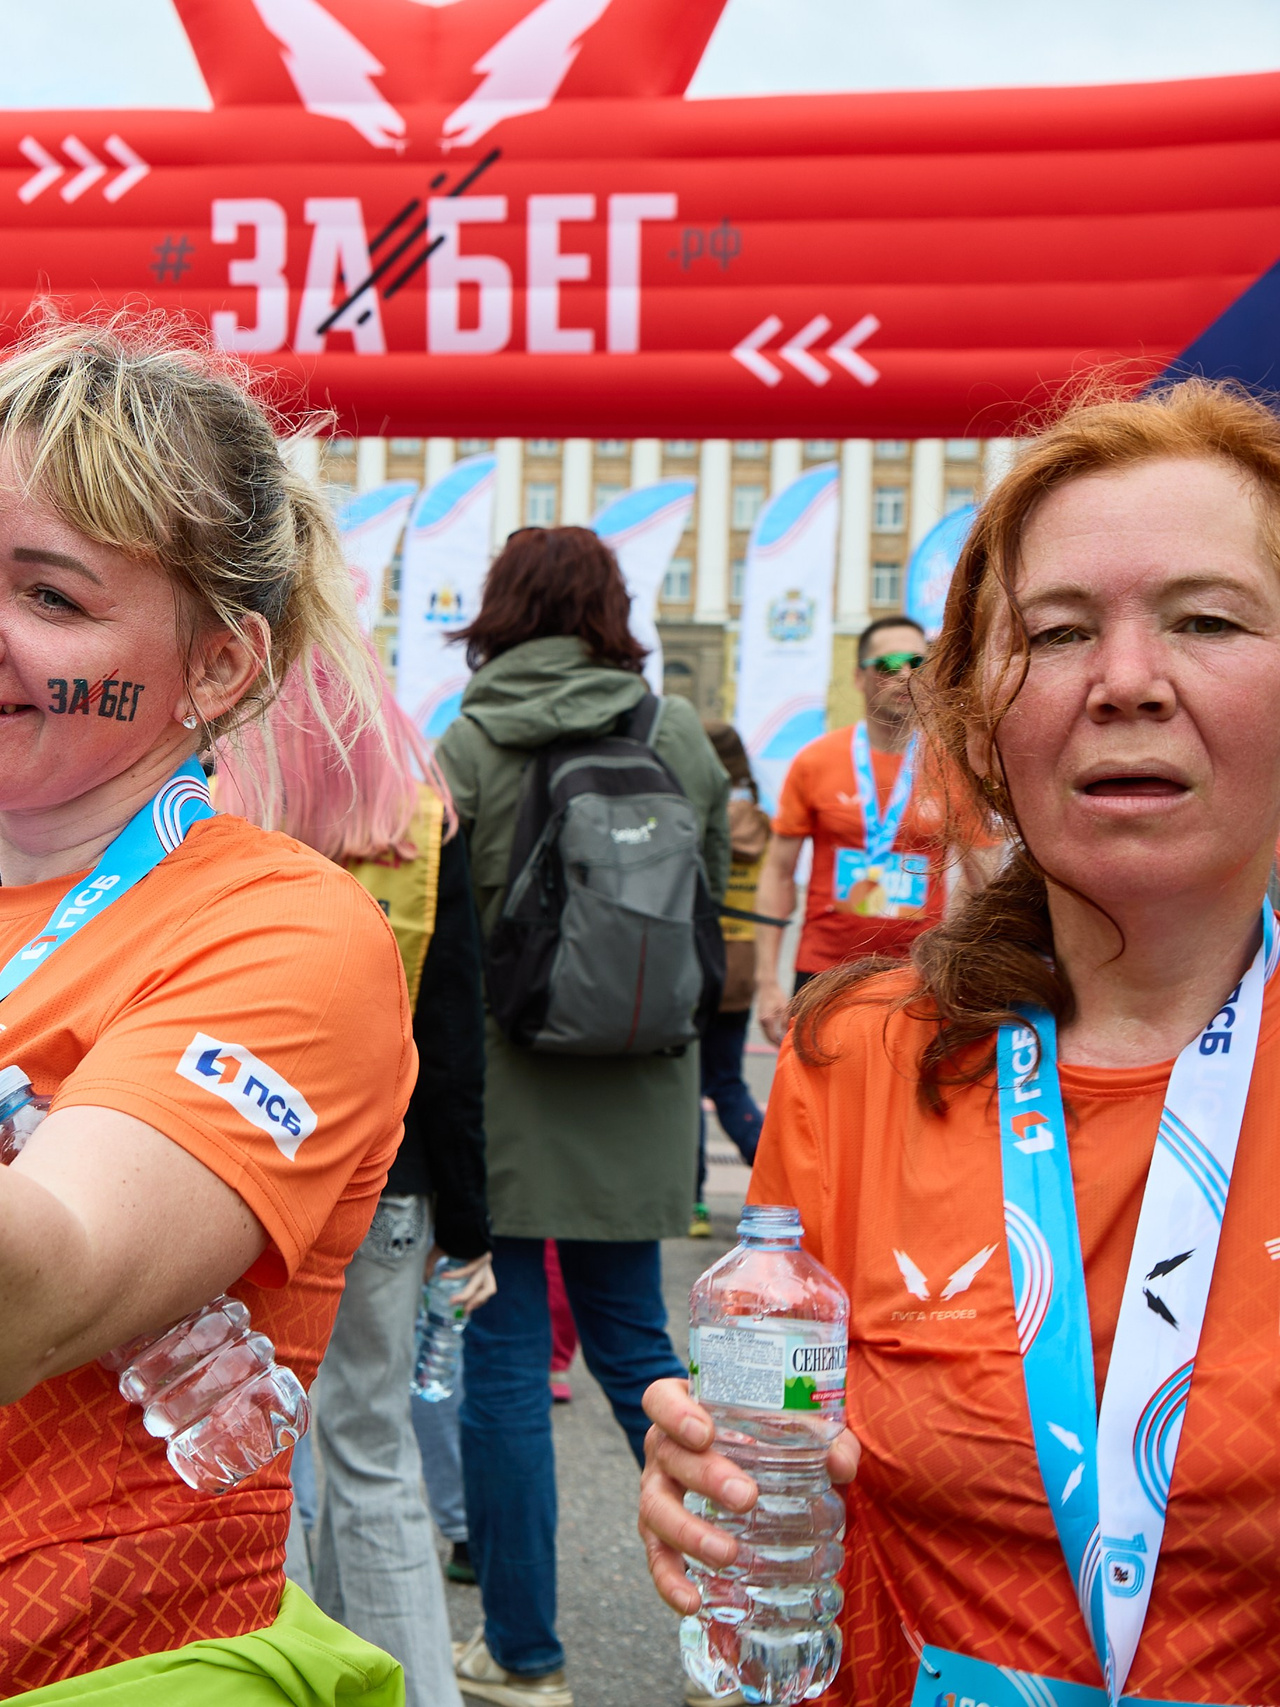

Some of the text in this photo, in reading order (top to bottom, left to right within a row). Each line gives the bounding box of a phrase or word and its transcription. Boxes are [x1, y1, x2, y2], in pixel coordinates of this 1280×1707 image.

[56, 874, 121, 929] ПСБ
[242, 1074, 301, 1137] ПСБ
[929, 1308, 978, 1321] ГЕРОЕВ
[1102, 1531, 1148, 1599] 10
